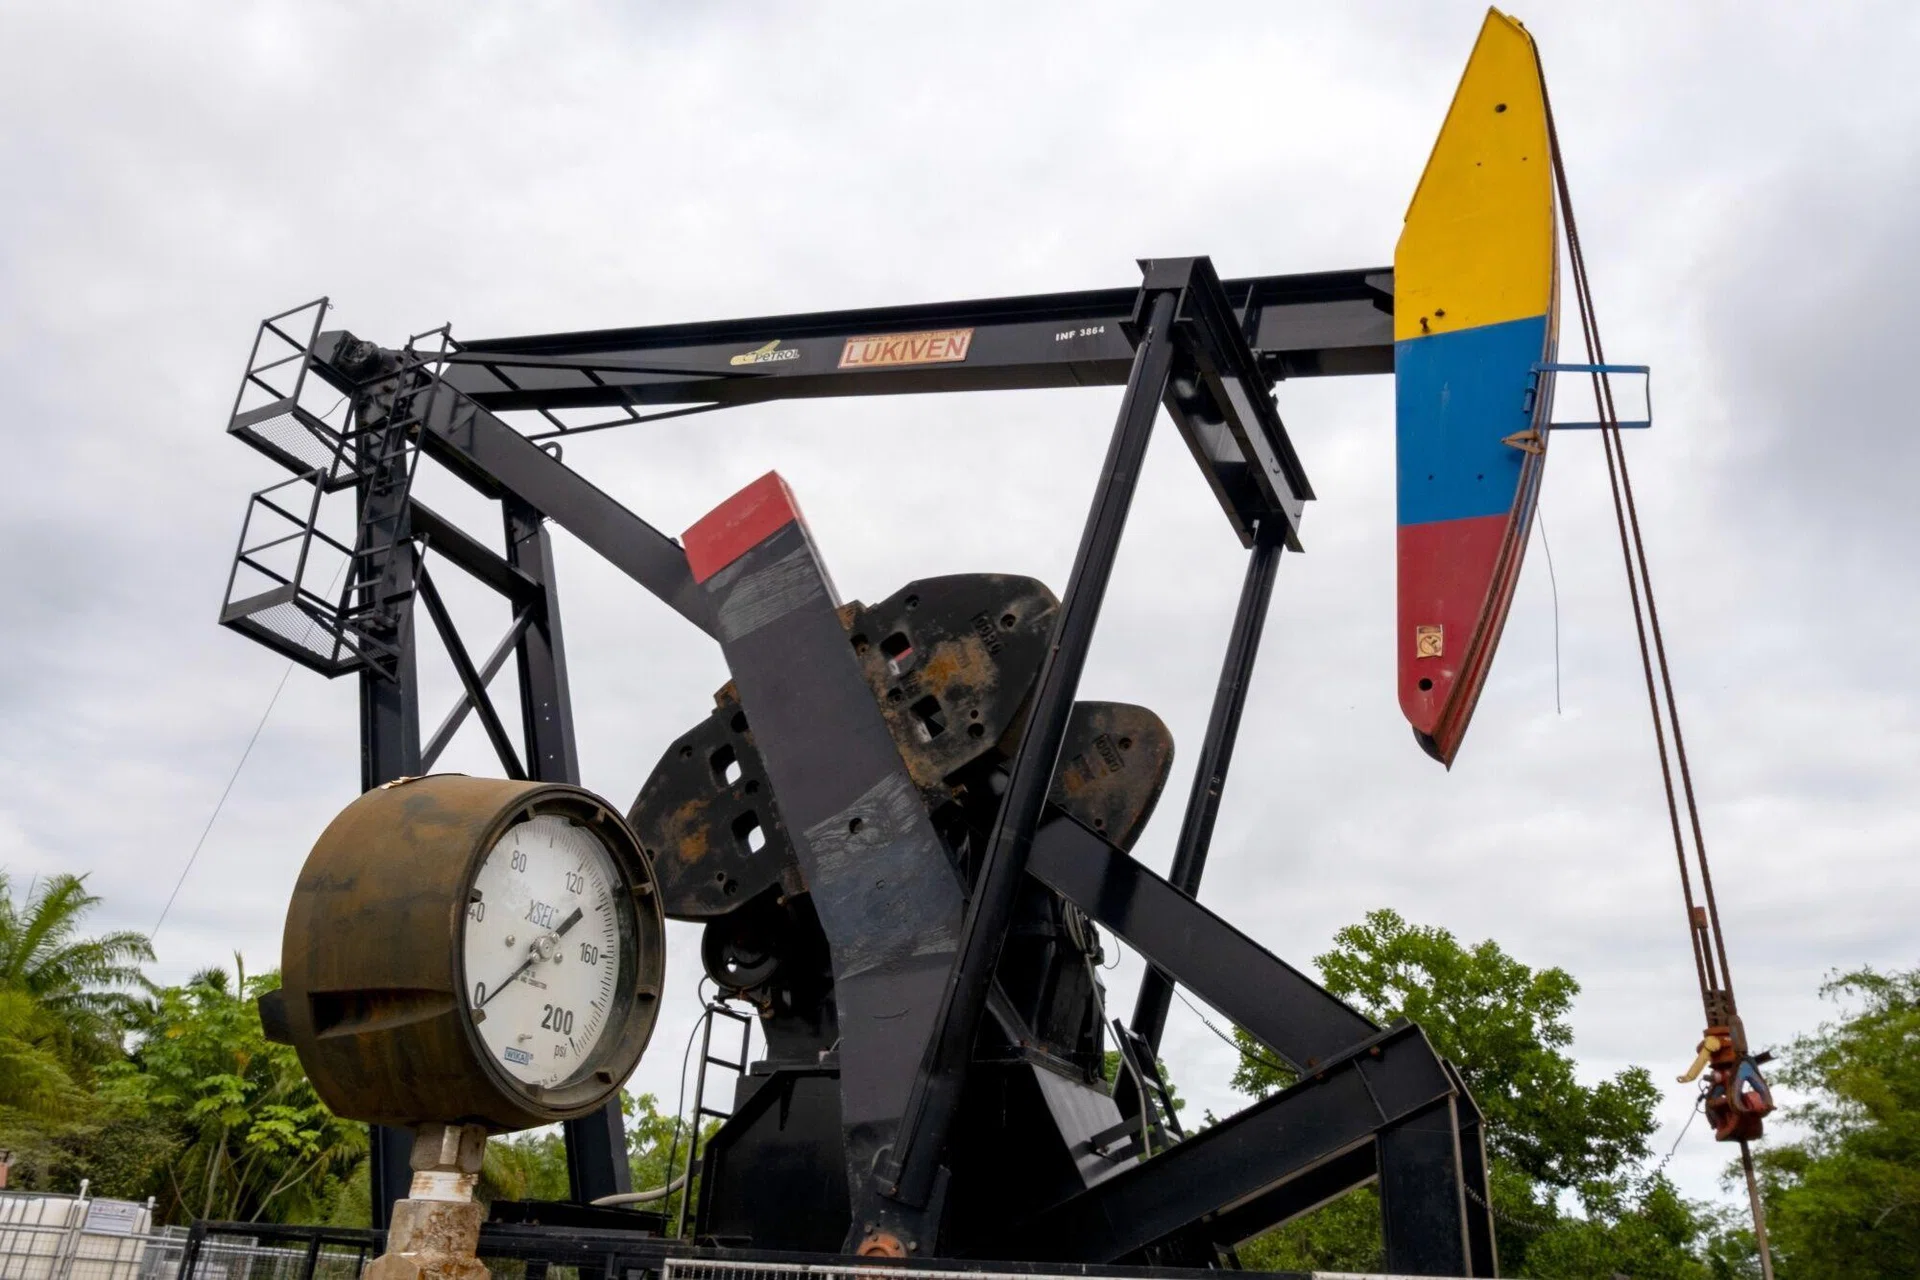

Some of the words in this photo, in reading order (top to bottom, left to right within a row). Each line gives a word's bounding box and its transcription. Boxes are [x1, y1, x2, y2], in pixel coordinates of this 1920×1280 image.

[1055, 330, 1076, 341] INF
[1079, 325, 1105, 337] 3864
[844, 336, 966, 364] LUKIVEN
[510, 850, 527, 873] 80
[565, 871, 584, 895] 120
[467, 902, 485, 923] 40
[579, 942, 598, 966] 160
[474, 982, 486, 1008] 0
[541, 1003, 573, 1036] 200
[553, 1043, 568, 1060] psi
